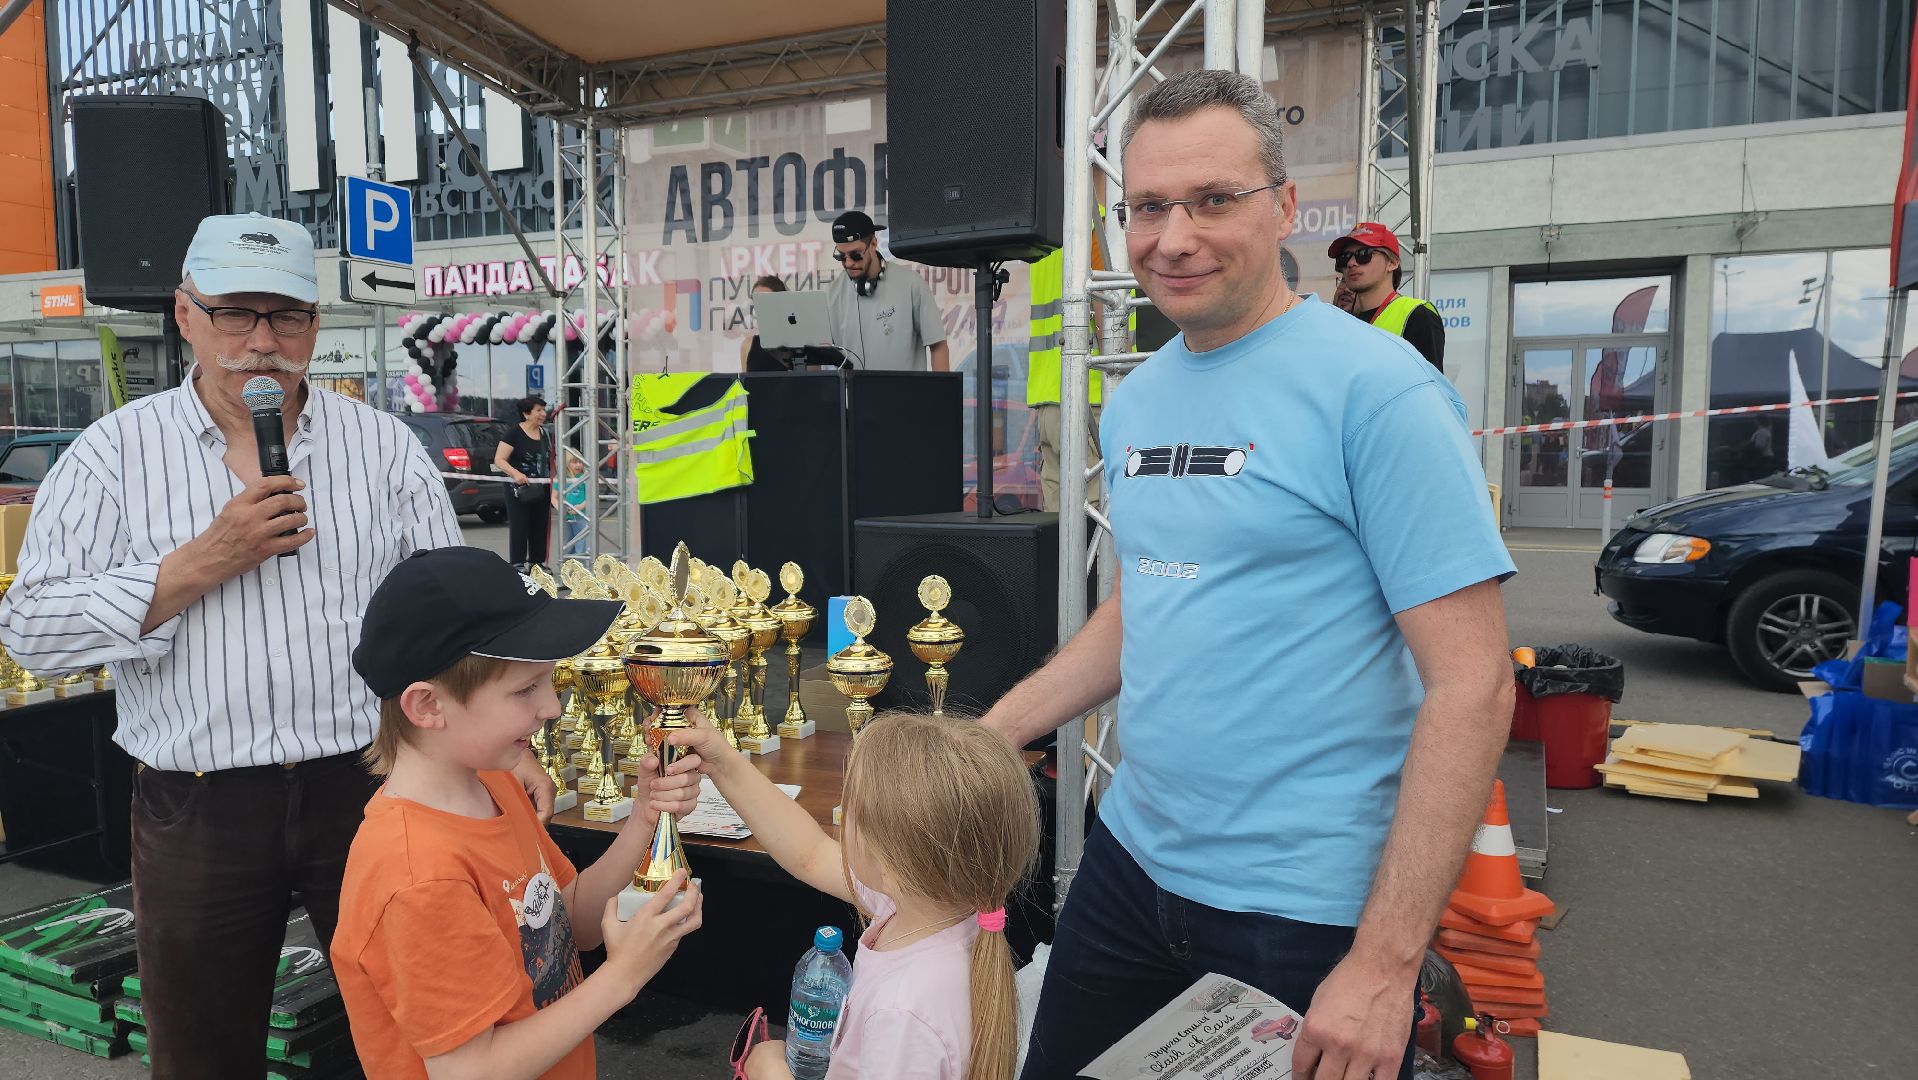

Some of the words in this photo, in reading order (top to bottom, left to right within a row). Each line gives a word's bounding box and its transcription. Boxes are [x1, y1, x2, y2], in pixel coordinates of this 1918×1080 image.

[364, 188, 400, 251] P
[424, 259, 534, 296] ПАНДА
[43, 295, 76, 308] STIHL
[1435, 298, 1467, 312] для
